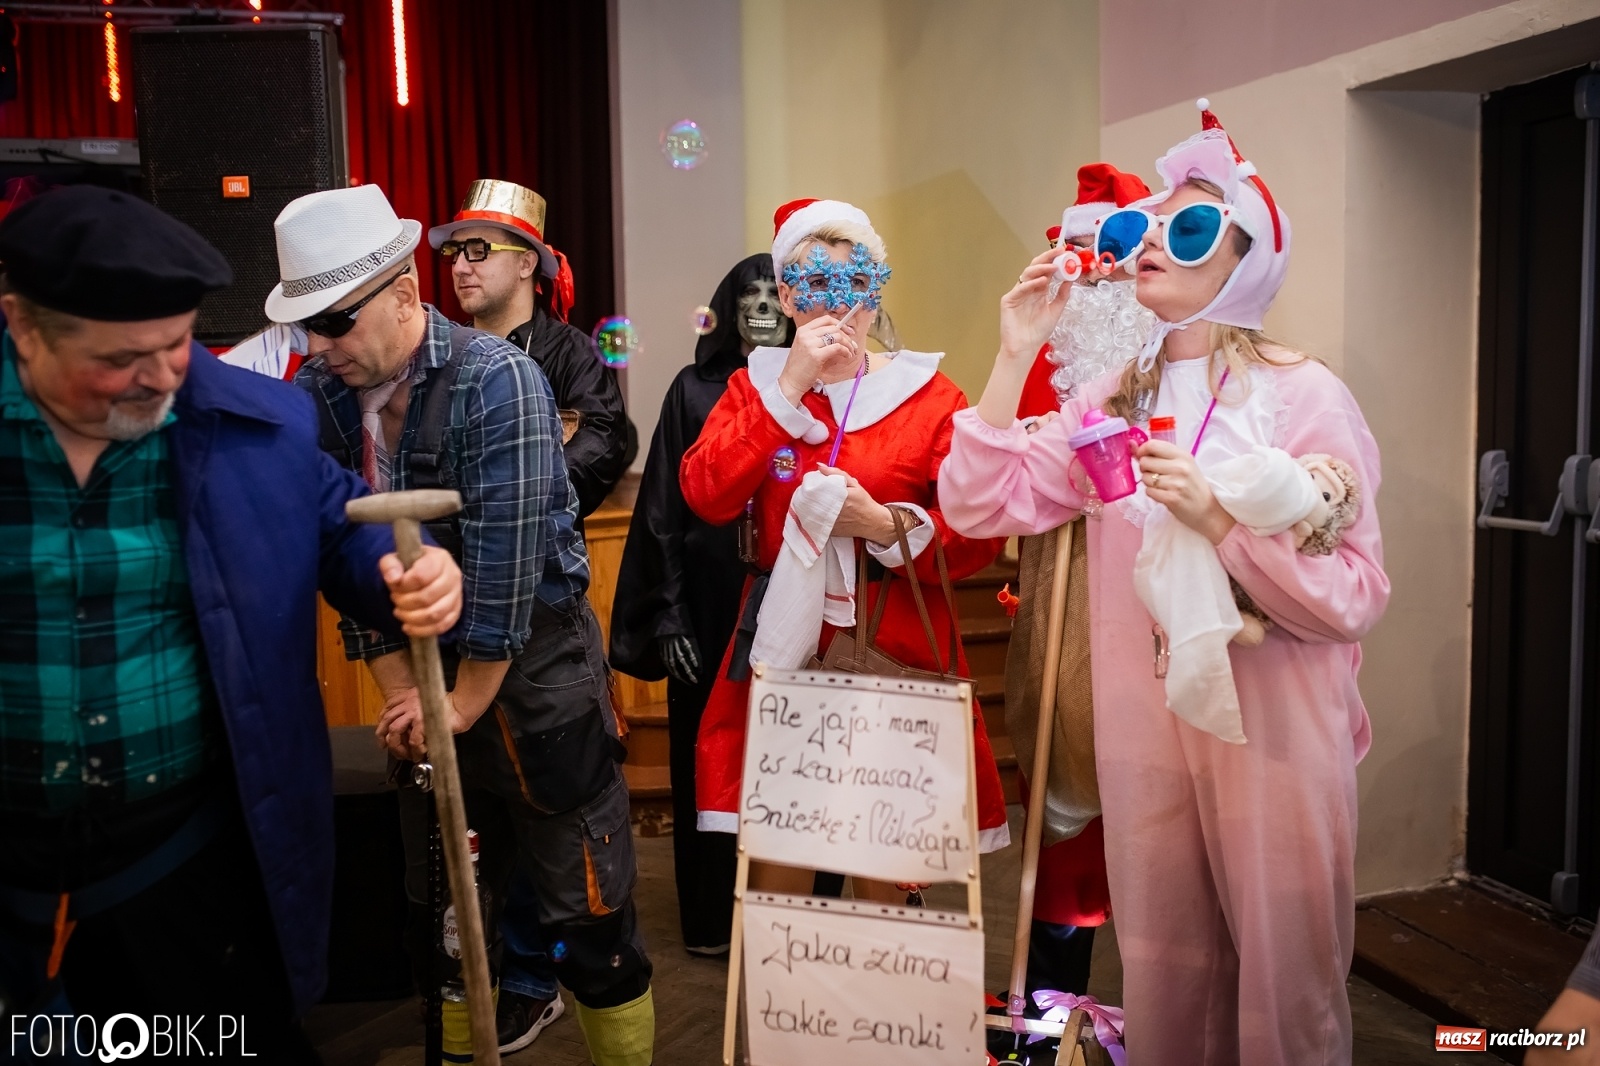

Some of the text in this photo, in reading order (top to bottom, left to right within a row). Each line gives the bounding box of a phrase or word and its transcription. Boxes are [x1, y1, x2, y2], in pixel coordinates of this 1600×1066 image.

[228, 182, 246, 193] JBL
[759, 693, 803, 728] Ale
[888, 716, 939, 754] mamy
[759, 752, 934, 794] w karnawale
[849, 814, 860, 841] i
[762, 921, 950, 983] Jaka zima
[760, 990, 840, 1037] takie
[847, 1013, 945, 1050] sanki
